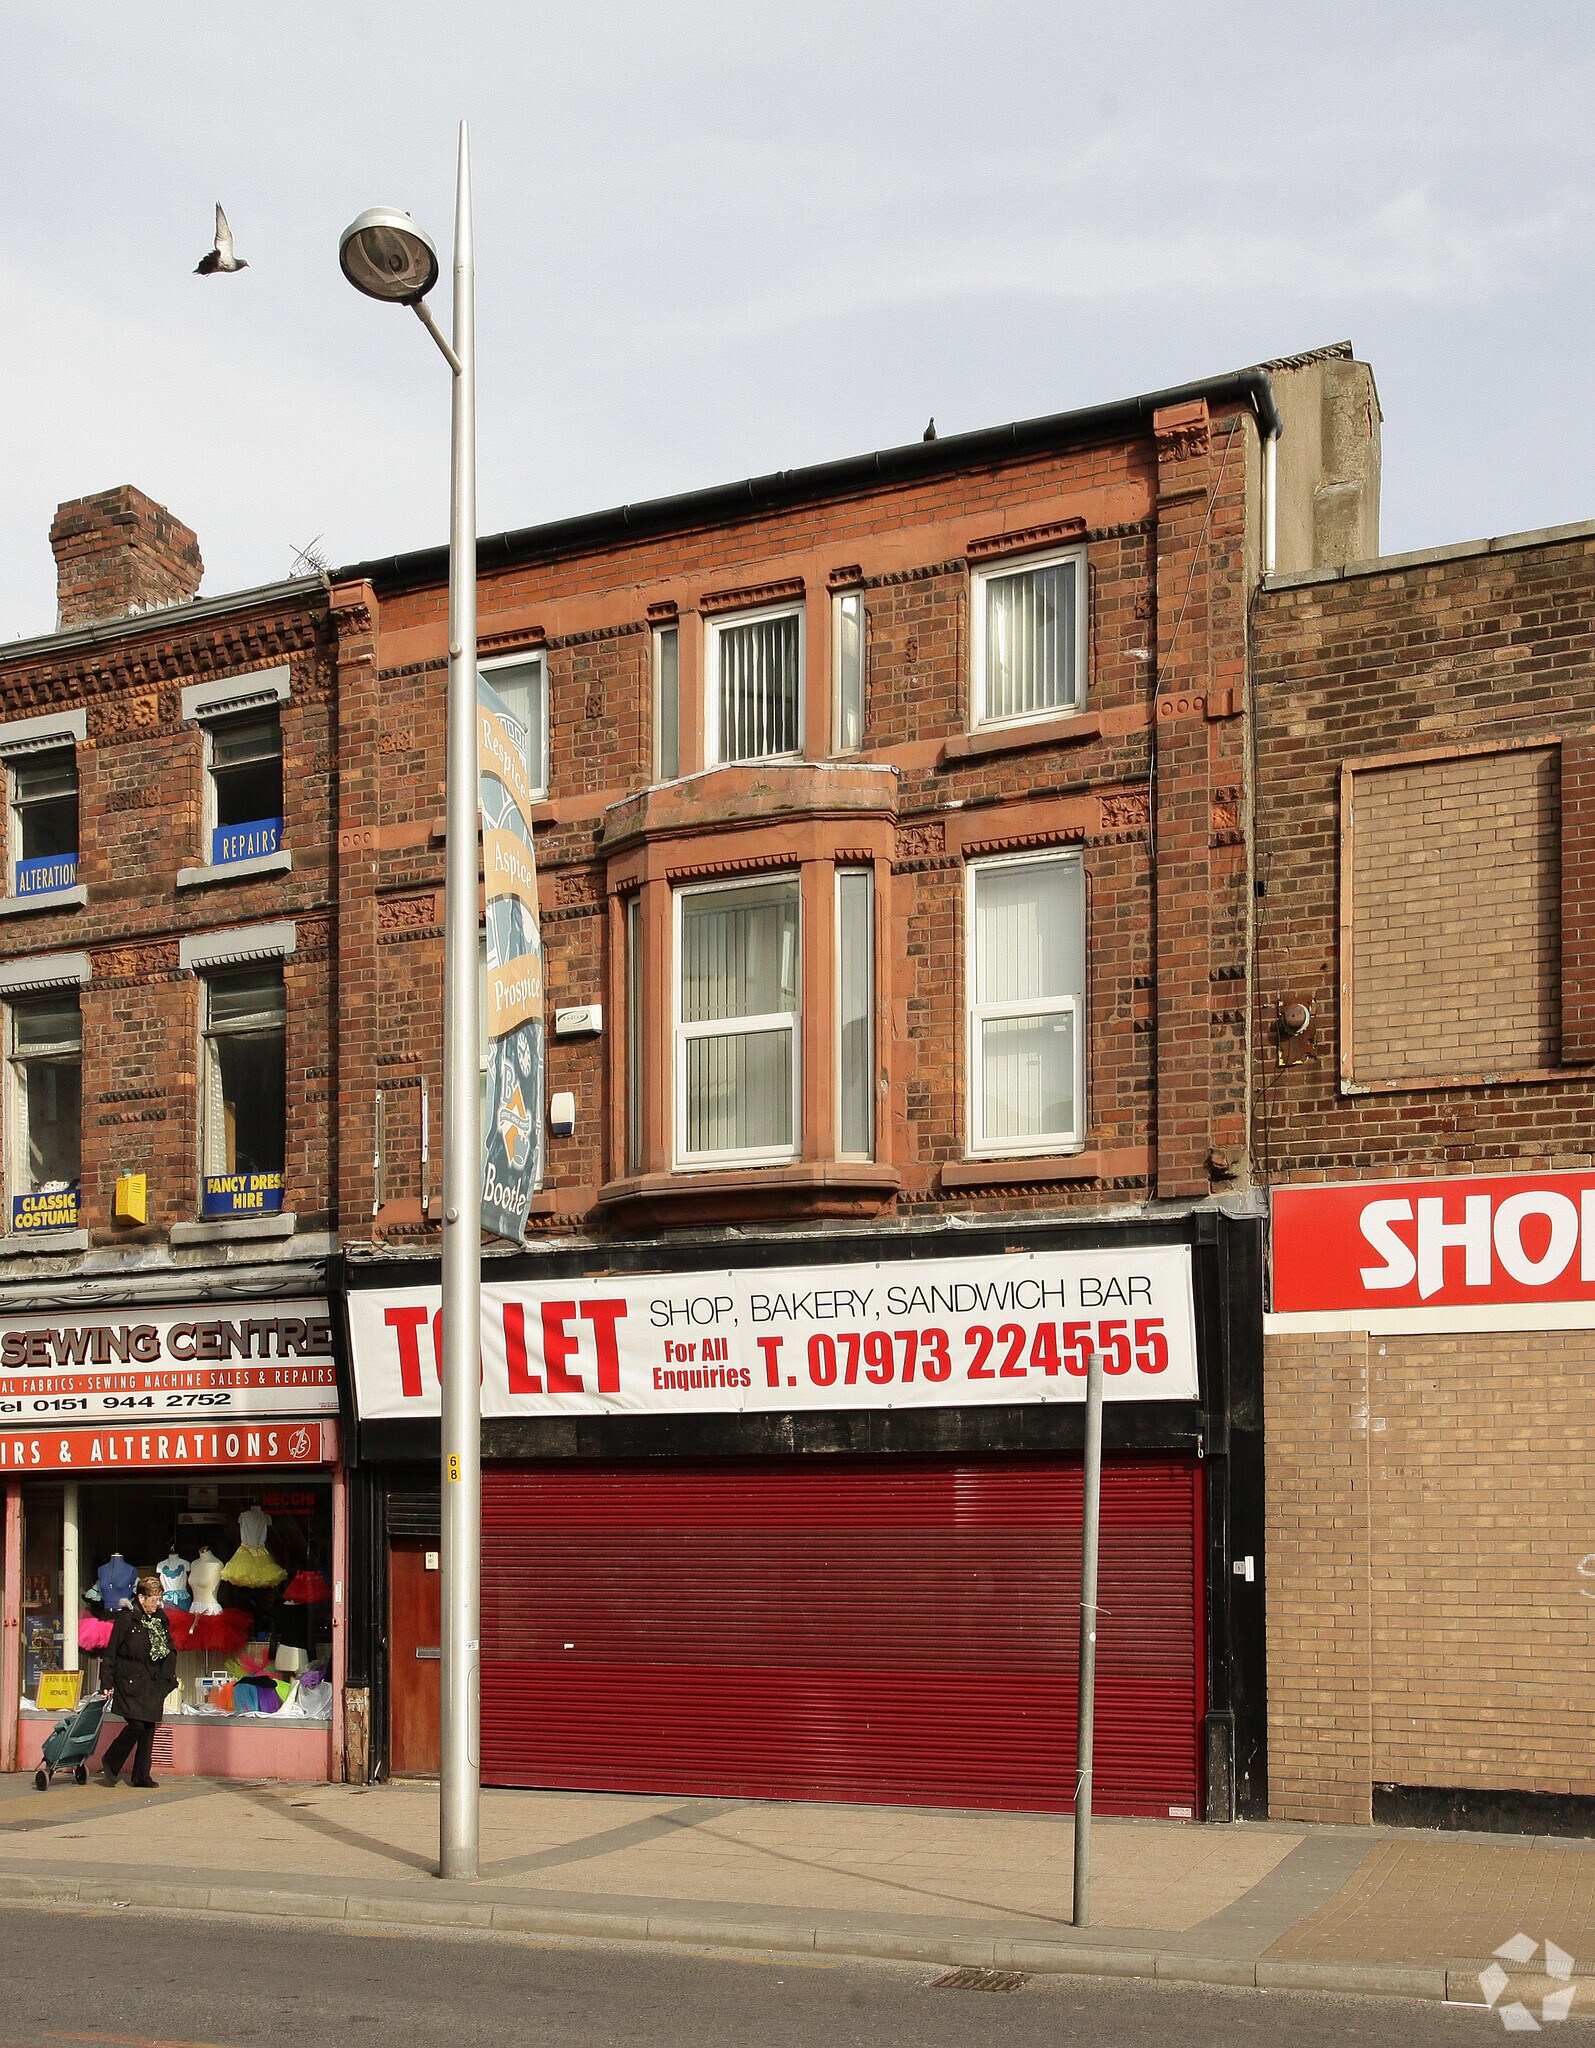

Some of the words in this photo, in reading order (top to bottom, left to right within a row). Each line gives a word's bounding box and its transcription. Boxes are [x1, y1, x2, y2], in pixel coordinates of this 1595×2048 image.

[481, 717, 527, 801] Respice
[223, 828, 276, 860] REPAIRS
[494, 840, 532, 889] Aspice
[493, 971, 541, 1013] Prospice
[207, 1176, 247, 1194] FANCY
[232, 1191, 263, 1209] HIRE
[483, 1162, 528, 1216] Bootle
[14, 1208, 79, 1229] COSTUME
[22, 1193, 76, 1212] CLASSIC
[1358, 1190, 1595, 1301] SHO
[650, 1295, 739, 1328] SHOP,
[751, 1288, 881, 1322] BAKERY,
[886, 1278, 1065, 1316] SANDWICH
[1080, 1276, 1153, 1307] BAR
[0, 1325, 161, 1368] SEWING
[166, 1316, 335, 1361] CENTRE
[384, 1302, 483, 1397] T
[502, 1298, 628, 1395] LET
[664, 1339, 697, 1363] For
[702, 1337, 729, 1361] All
[757, 1336, 797, 1387] T.
[807, 1328, 952, 1387] 07973
[964, 1317, 1169, 1380] 224555
[23, 1377, 75, 1393] FABRICS
[87, 1375, 137, 1390] SEWING
[144, 1371, 202, 1387] MACHINE
[210, 1368, 250, 1386] SALES
[258, 1368, 266, 1384] &
[275, 1369, 333, 1384] REPAIRS
[653, 1364, 751, 1391] Enquiries
[32, 1397, 88, 1412] 0151
[102, 1395, 155, 1409] 944
[166, 1392, 232, 1408] 2752
[59, 1440, 72, 1463] &
[90, 1431, 279, 1462] ALTERATIONS
[262, 1493, 315, 1506] NECCHI
